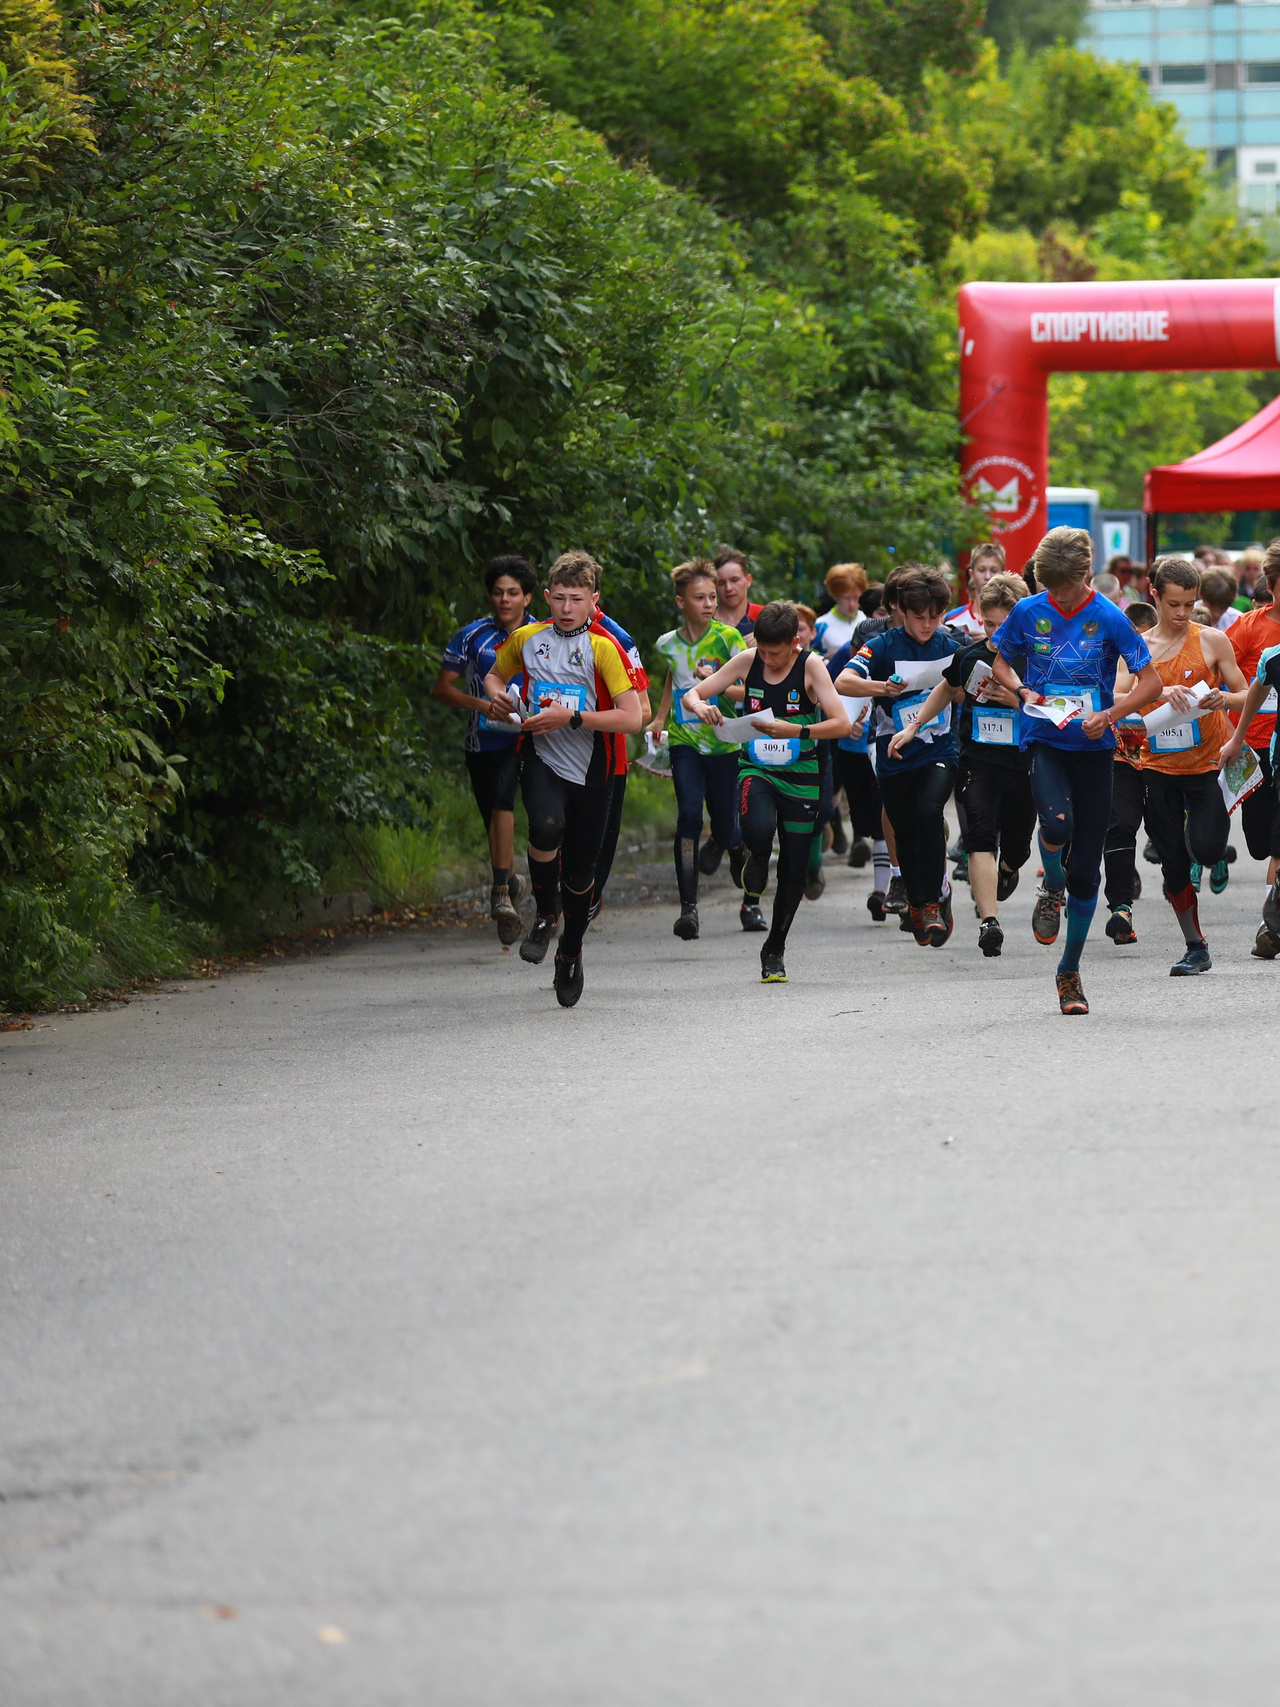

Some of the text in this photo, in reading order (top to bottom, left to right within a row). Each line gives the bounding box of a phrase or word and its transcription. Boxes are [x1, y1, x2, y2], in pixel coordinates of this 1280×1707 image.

[1030, 311, 1169, 343] СПОРТИВНОЕ
[982, 723, 1003, 732] 317.1
[762, 743, 785, 752] 309.1
